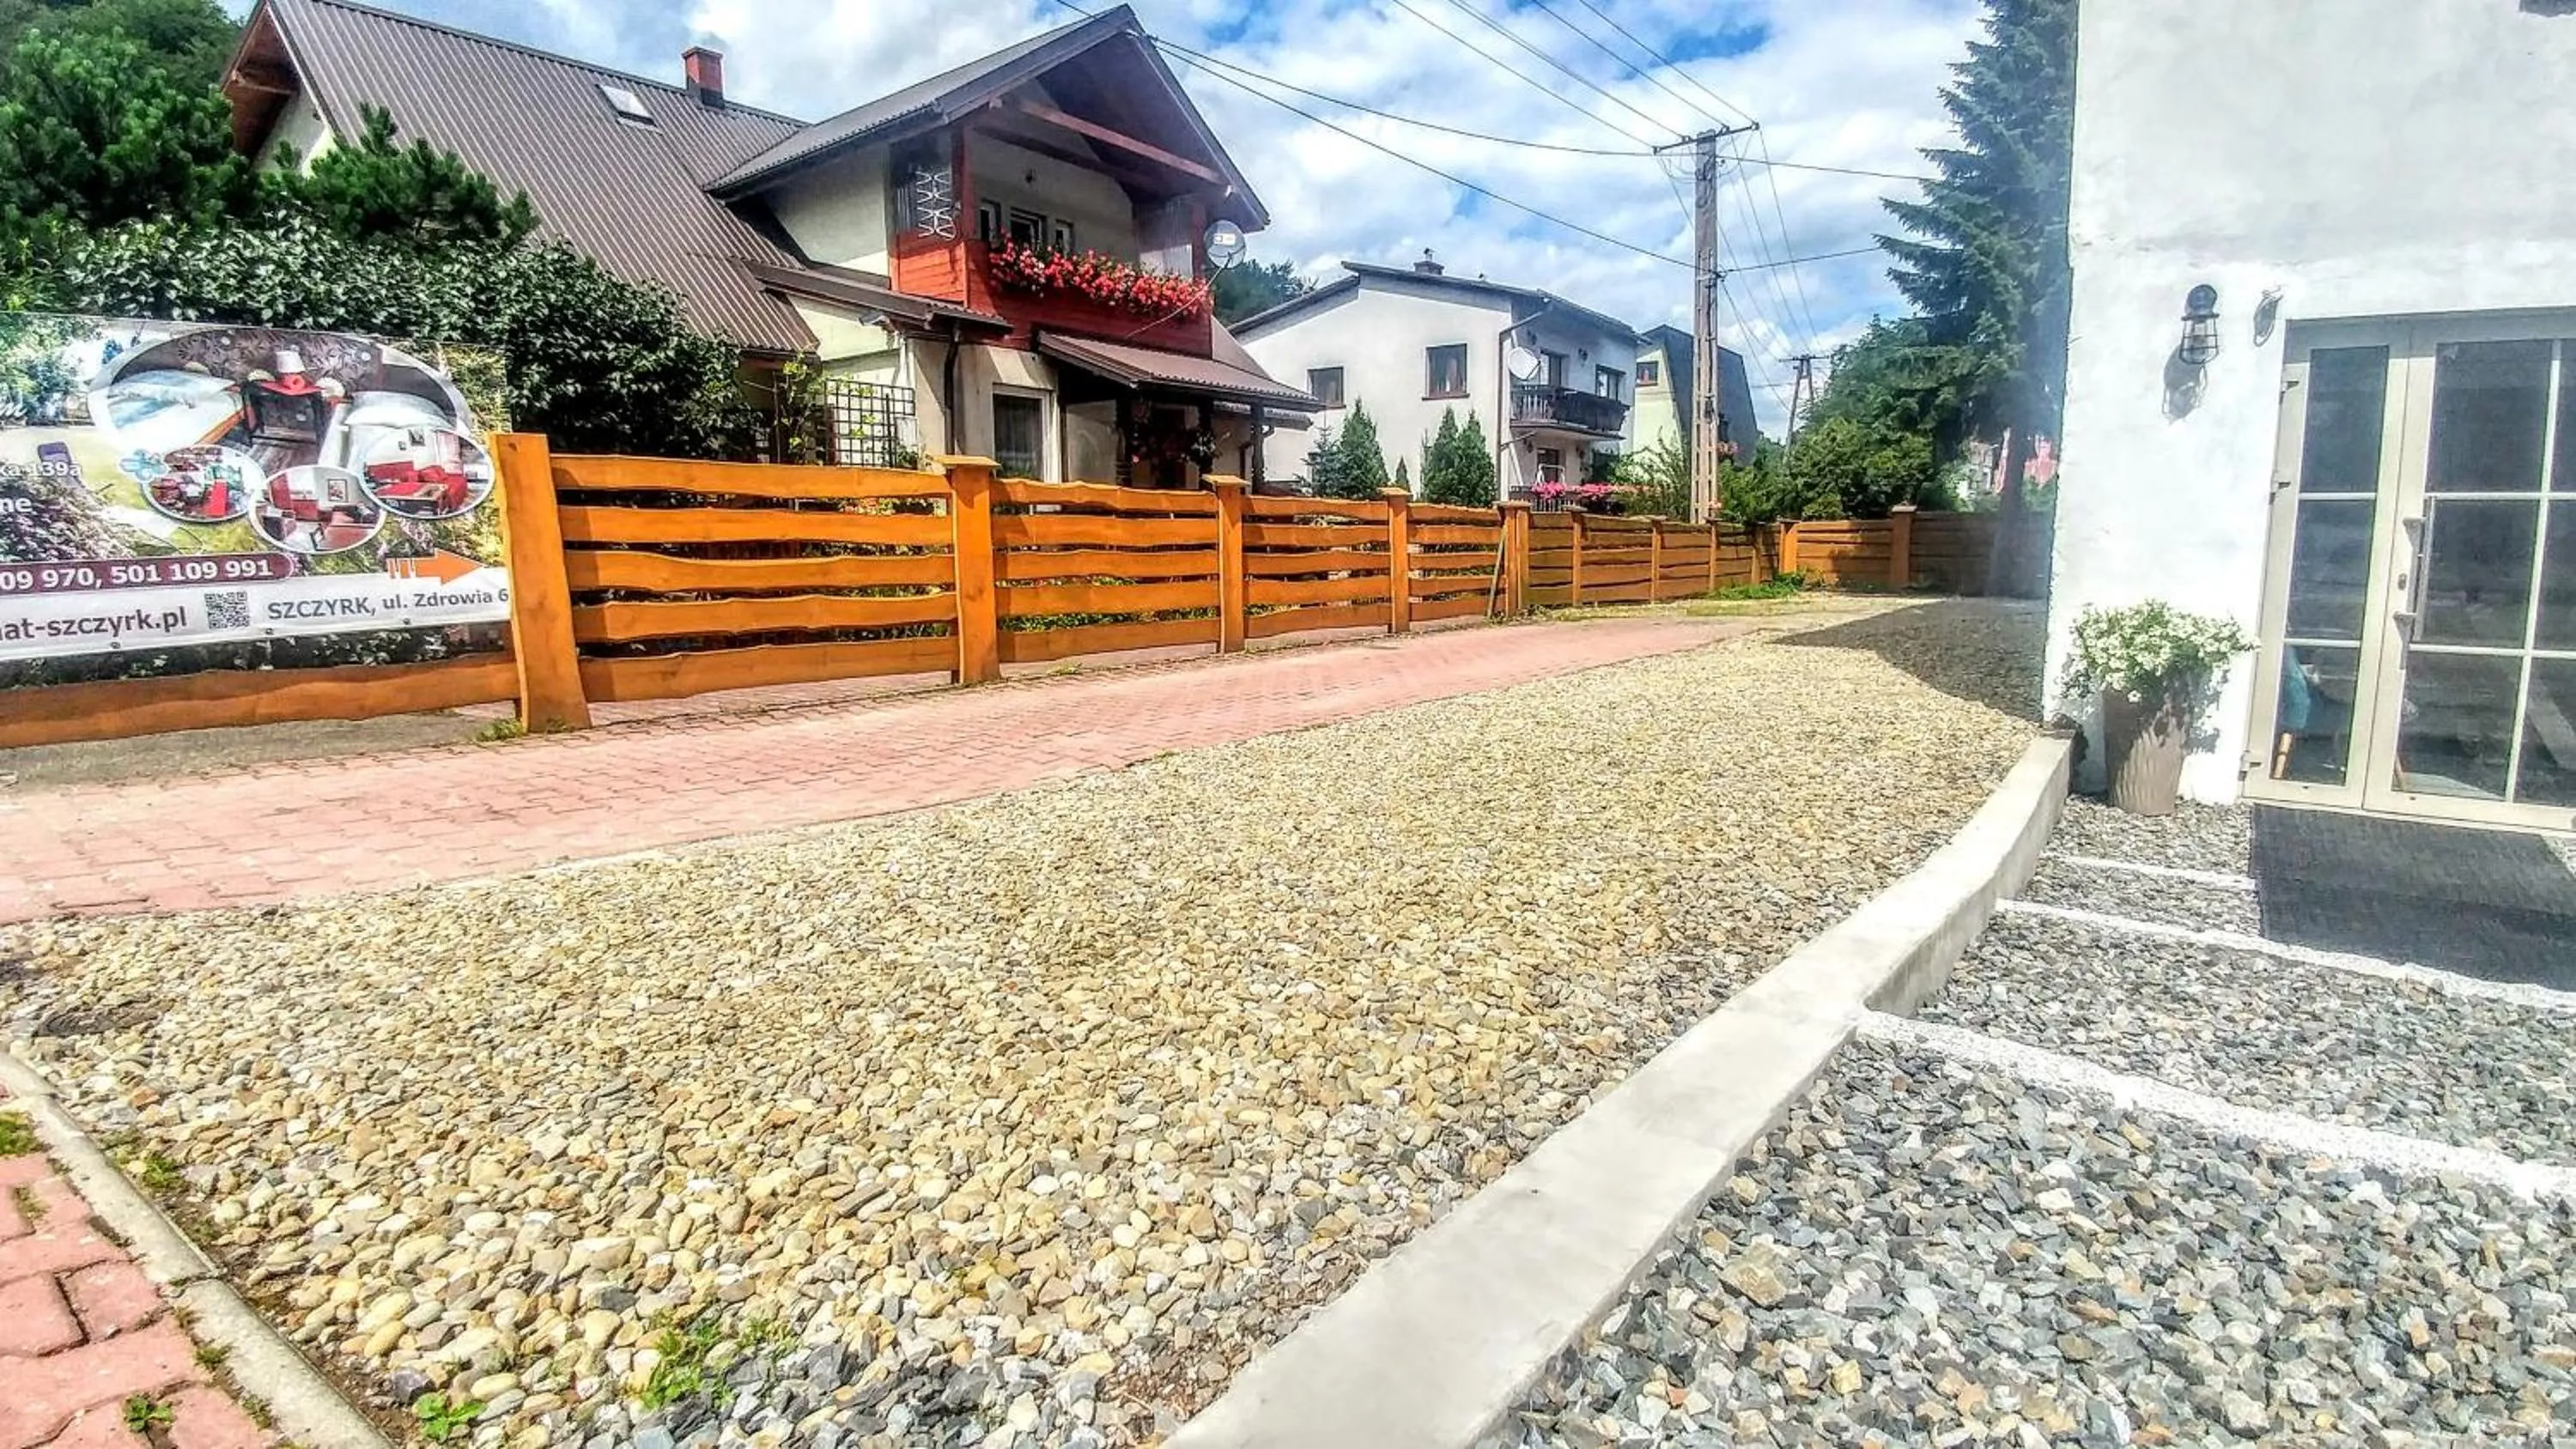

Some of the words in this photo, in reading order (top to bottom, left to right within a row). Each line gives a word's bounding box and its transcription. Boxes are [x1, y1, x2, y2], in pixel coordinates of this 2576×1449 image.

[42, 567, 101, 589] 970,
[110, 565, 161, 584] 501
[169, 561, 218, 581] 109
[225, 559, 273, 578] 991
[267, 597, 376, 620] SZCZYRK,
[383, 596, 408, 610] ul.
[414, 589, 493, 608] Zdrowia
[0, 606, 187, 640] at-szczyrk.pl
